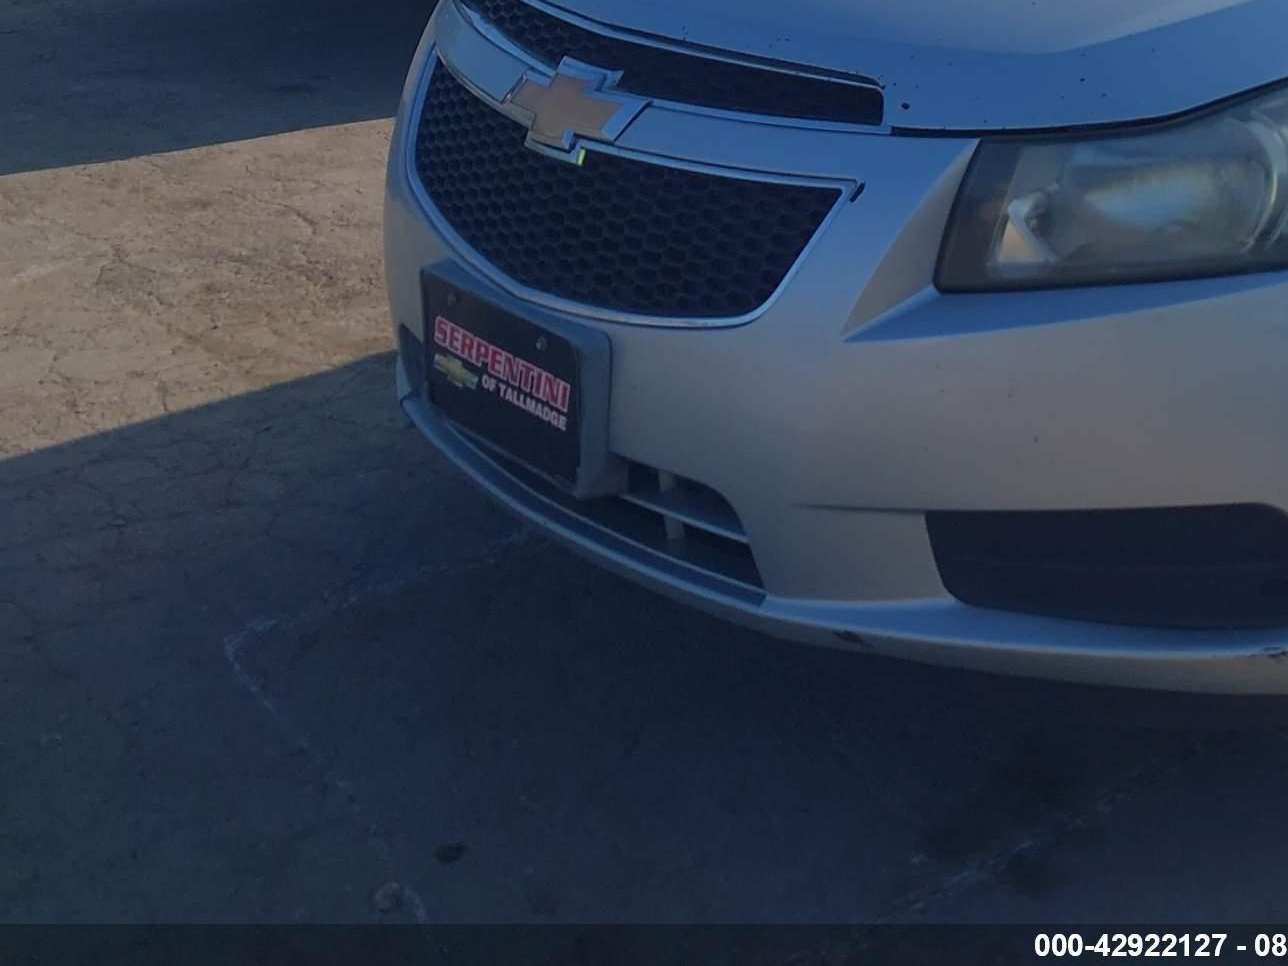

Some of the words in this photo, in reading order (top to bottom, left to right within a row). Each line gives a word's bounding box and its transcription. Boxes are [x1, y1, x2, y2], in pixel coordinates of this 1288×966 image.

[433, 315, 571, 414] SERPENTINI
[481, 374, 496, 392] OF
[498, 382, 568, 432] TALLMADGE
